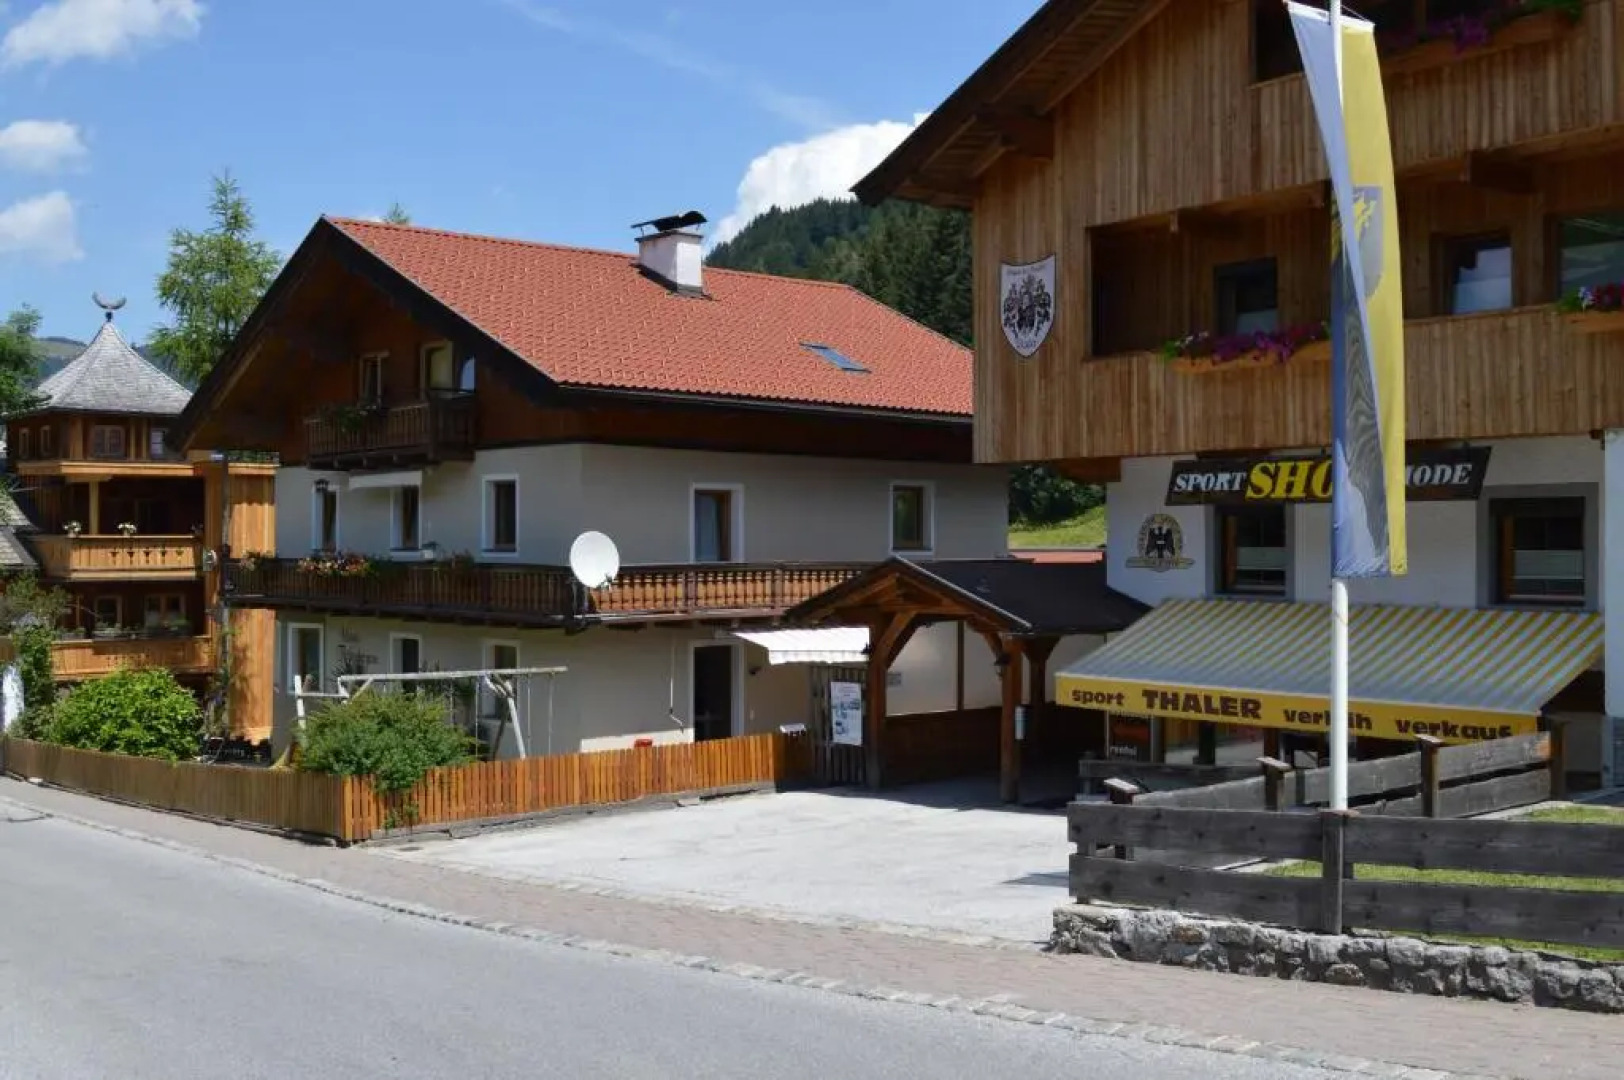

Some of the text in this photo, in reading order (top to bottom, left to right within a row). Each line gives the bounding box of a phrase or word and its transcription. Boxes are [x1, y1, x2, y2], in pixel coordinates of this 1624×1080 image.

[1173, 459, 1473, 499] SPORT SHO ODE
[1072, 689, 1125, 706] sport
[1142, 689, 1262, 719] THALER
[1283, 708, 1372, 730] verlih
